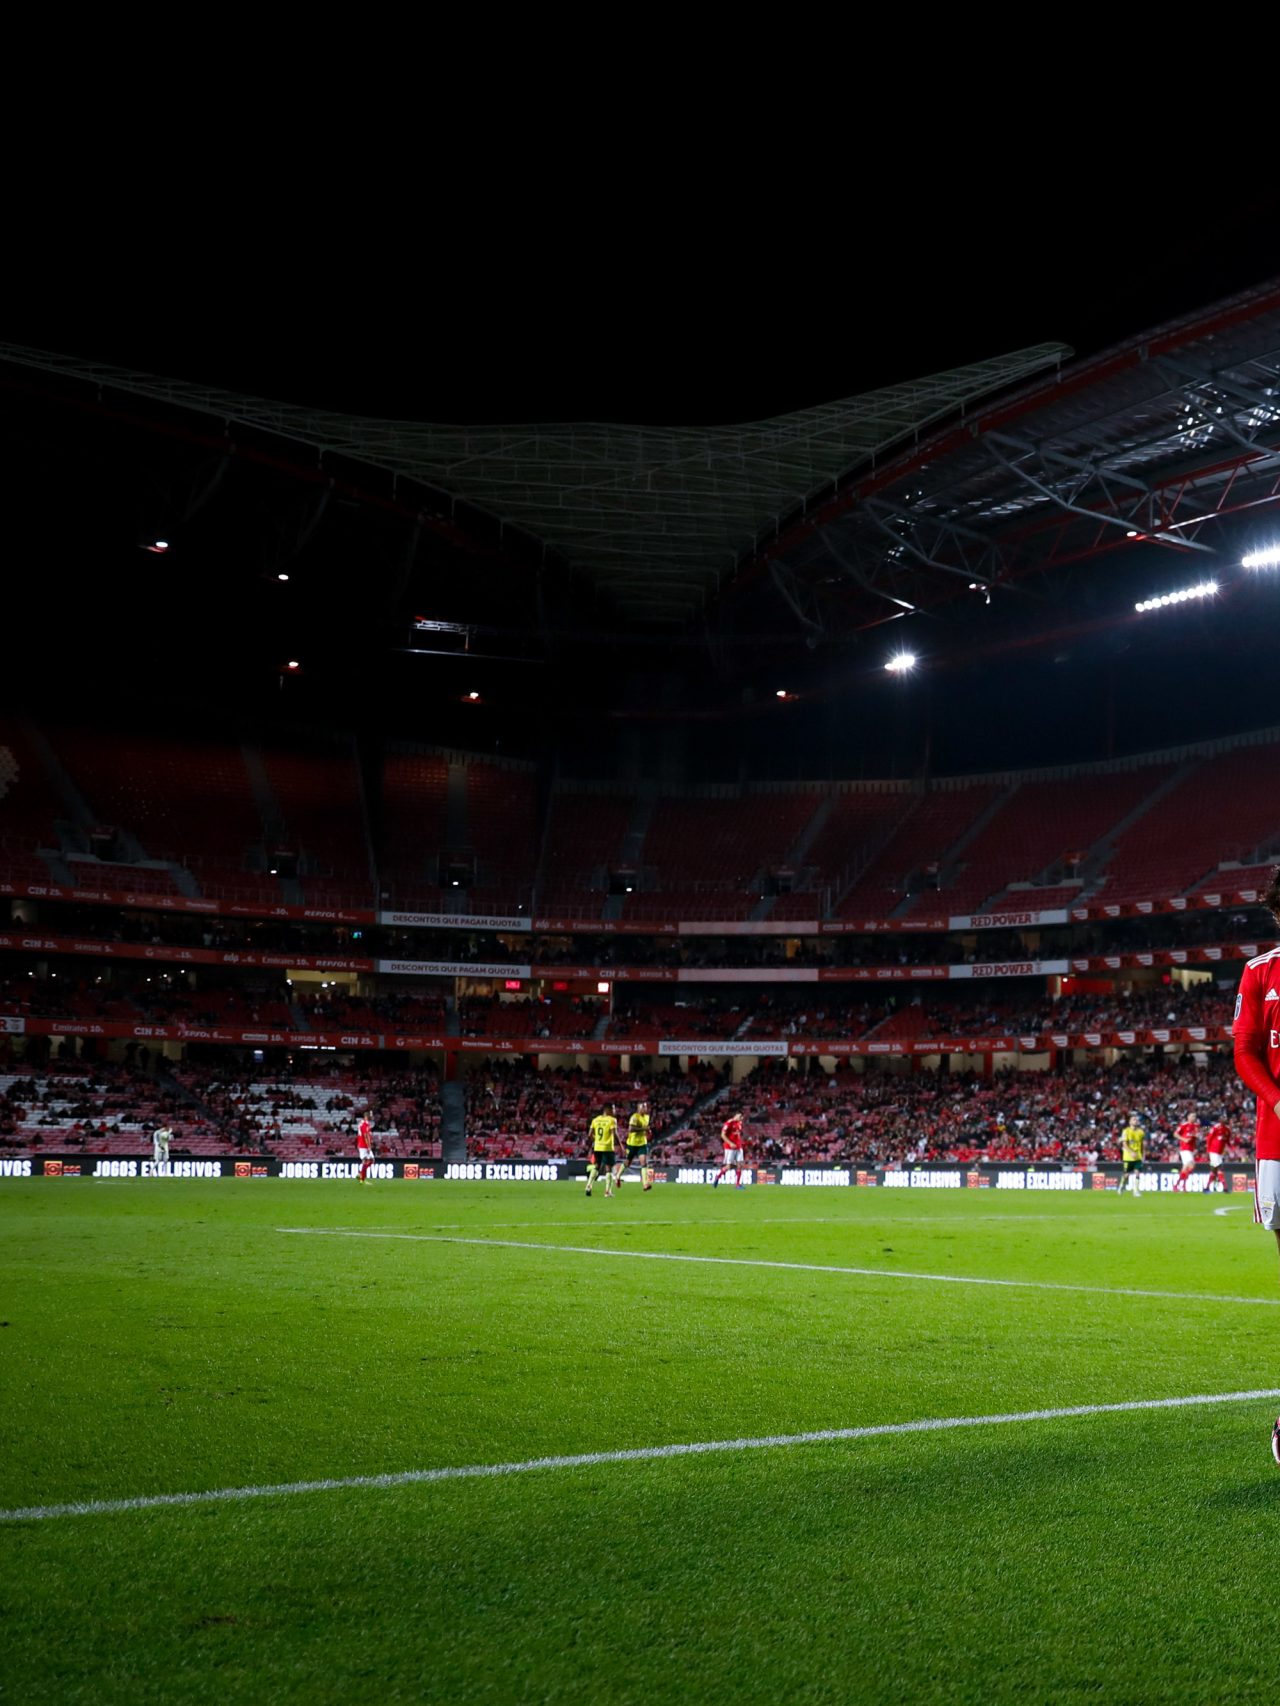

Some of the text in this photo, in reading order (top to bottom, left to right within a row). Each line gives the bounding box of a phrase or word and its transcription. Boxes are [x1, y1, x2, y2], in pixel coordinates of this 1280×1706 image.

[393, 915, 521, 927] DESCONTOS QUE PAGAM QUOTAS
[971, 914, 1031, 927] RED POWER
[392, 964, 439, 972] DESCONTOS
[972, 964, 1033, 976] RED POWER
[663, 1043, 706, 1051] DESCONTOS
[708, 1044, 724, 1052] QUE
[753, 1044, 783, 1052] QUOTAS
[597, 1127, 604, 1141] 9
[92, 1160, 137, 1177] JOGOS
[279, 1163, 318, 1178] JOGOS
[444, 1164, 558, 1180] JOGOS EXCLUSIVOS
